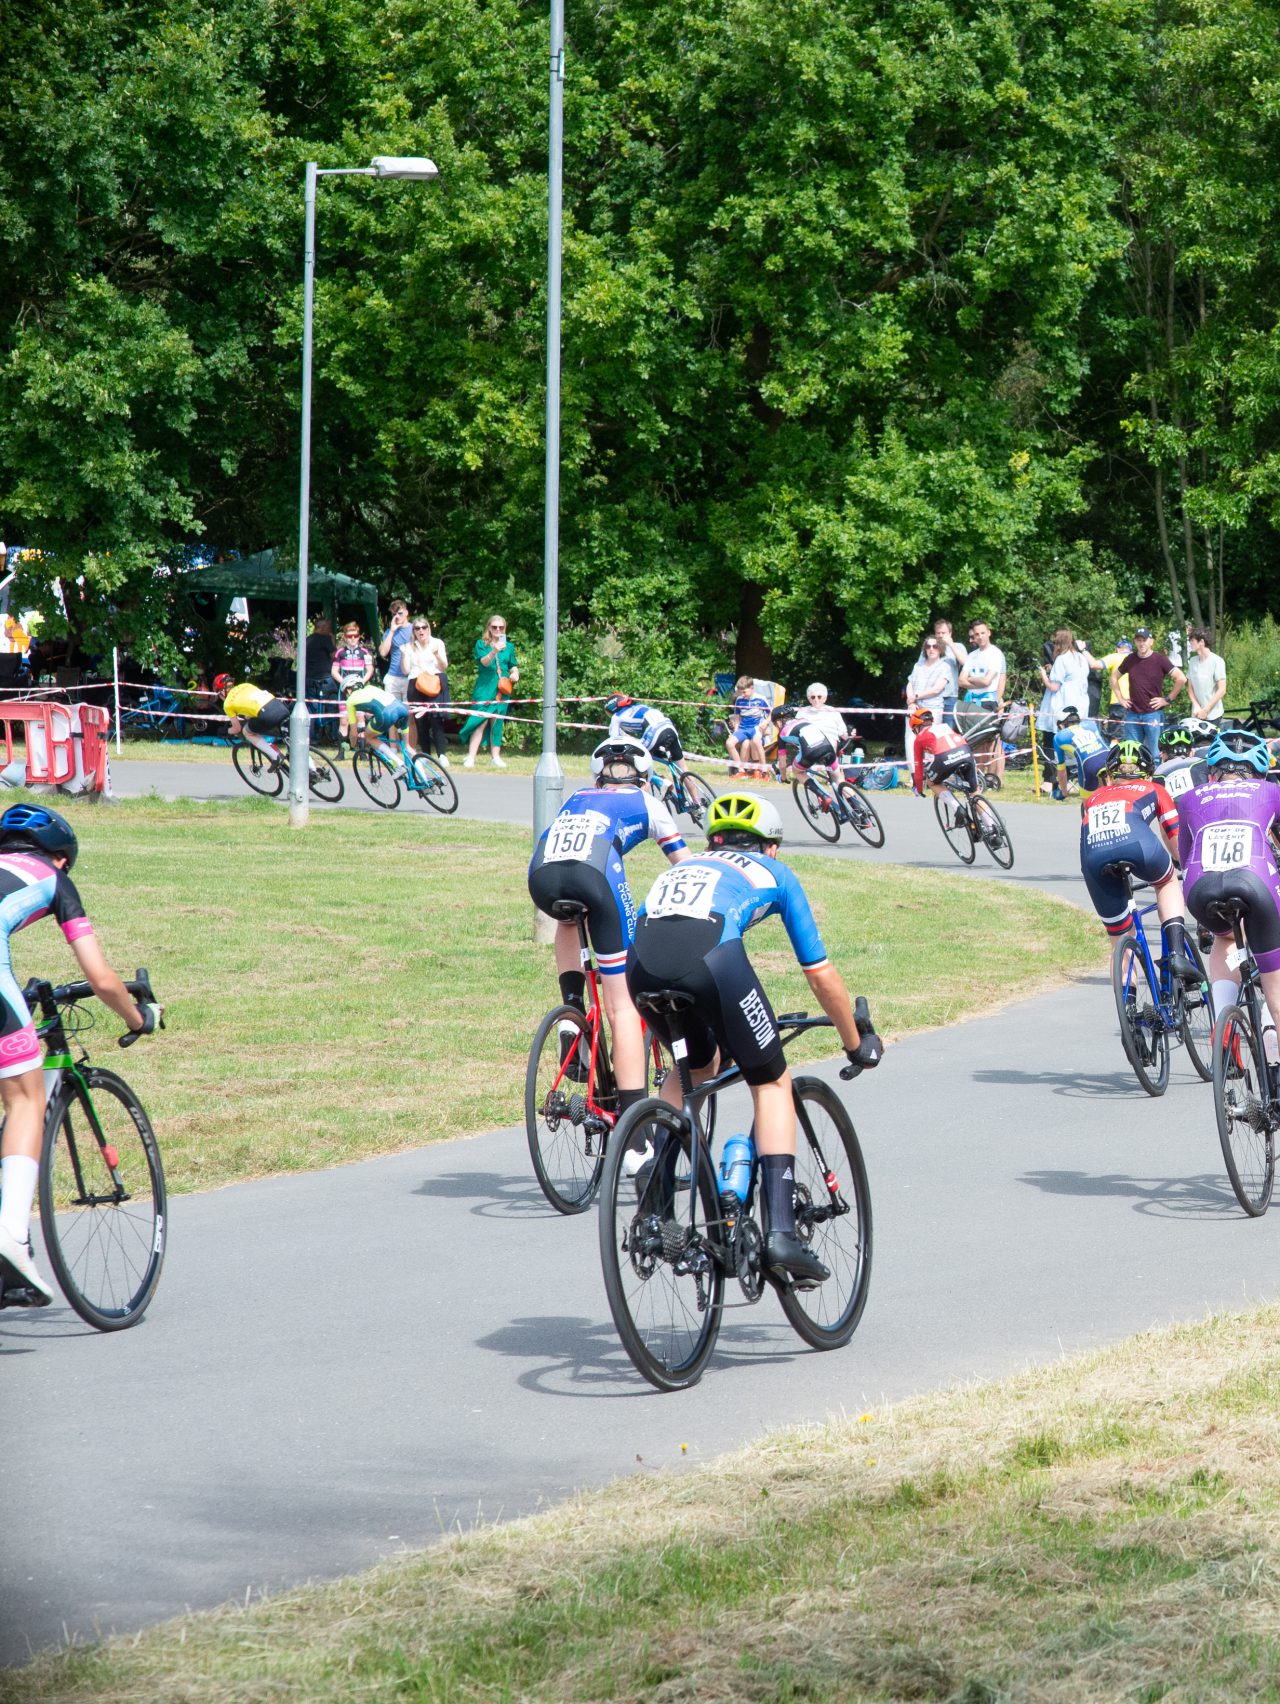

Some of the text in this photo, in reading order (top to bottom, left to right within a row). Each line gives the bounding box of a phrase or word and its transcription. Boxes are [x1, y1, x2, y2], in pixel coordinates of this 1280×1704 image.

[1093, 808, 1121, 828] 152
[552, 832, 587, 854] 150
[1209, 841, 1245, 865] 148
[617, 883, 632, 917] CYCLING
[657, 882, 708, 906] 157
[738, 987, 776, 1050] BEESTON
